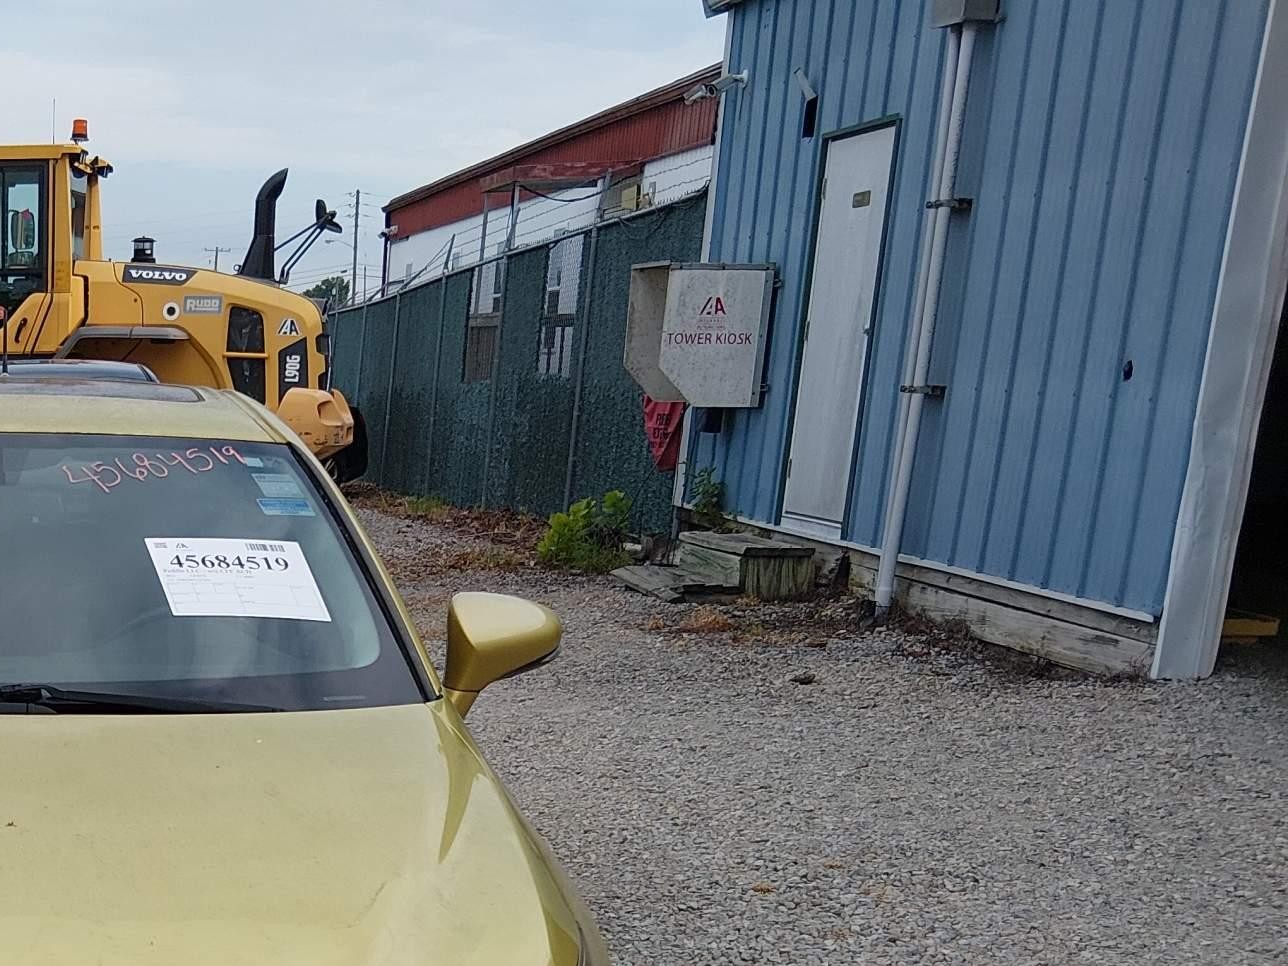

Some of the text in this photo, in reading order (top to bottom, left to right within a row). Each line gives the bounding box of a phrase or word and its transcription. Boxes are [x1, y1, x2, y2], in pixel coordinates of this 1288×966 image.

[128, 269, 187, 282] VOLVO
[186, 298, 220, 312] RUDD
[667, 332, 752, 345] TOWER KIOSK
[284, 354, 301, 383] L90G
[62, 445, 248, 493] 45684519
[170, 554, 289, 571] 45684519
